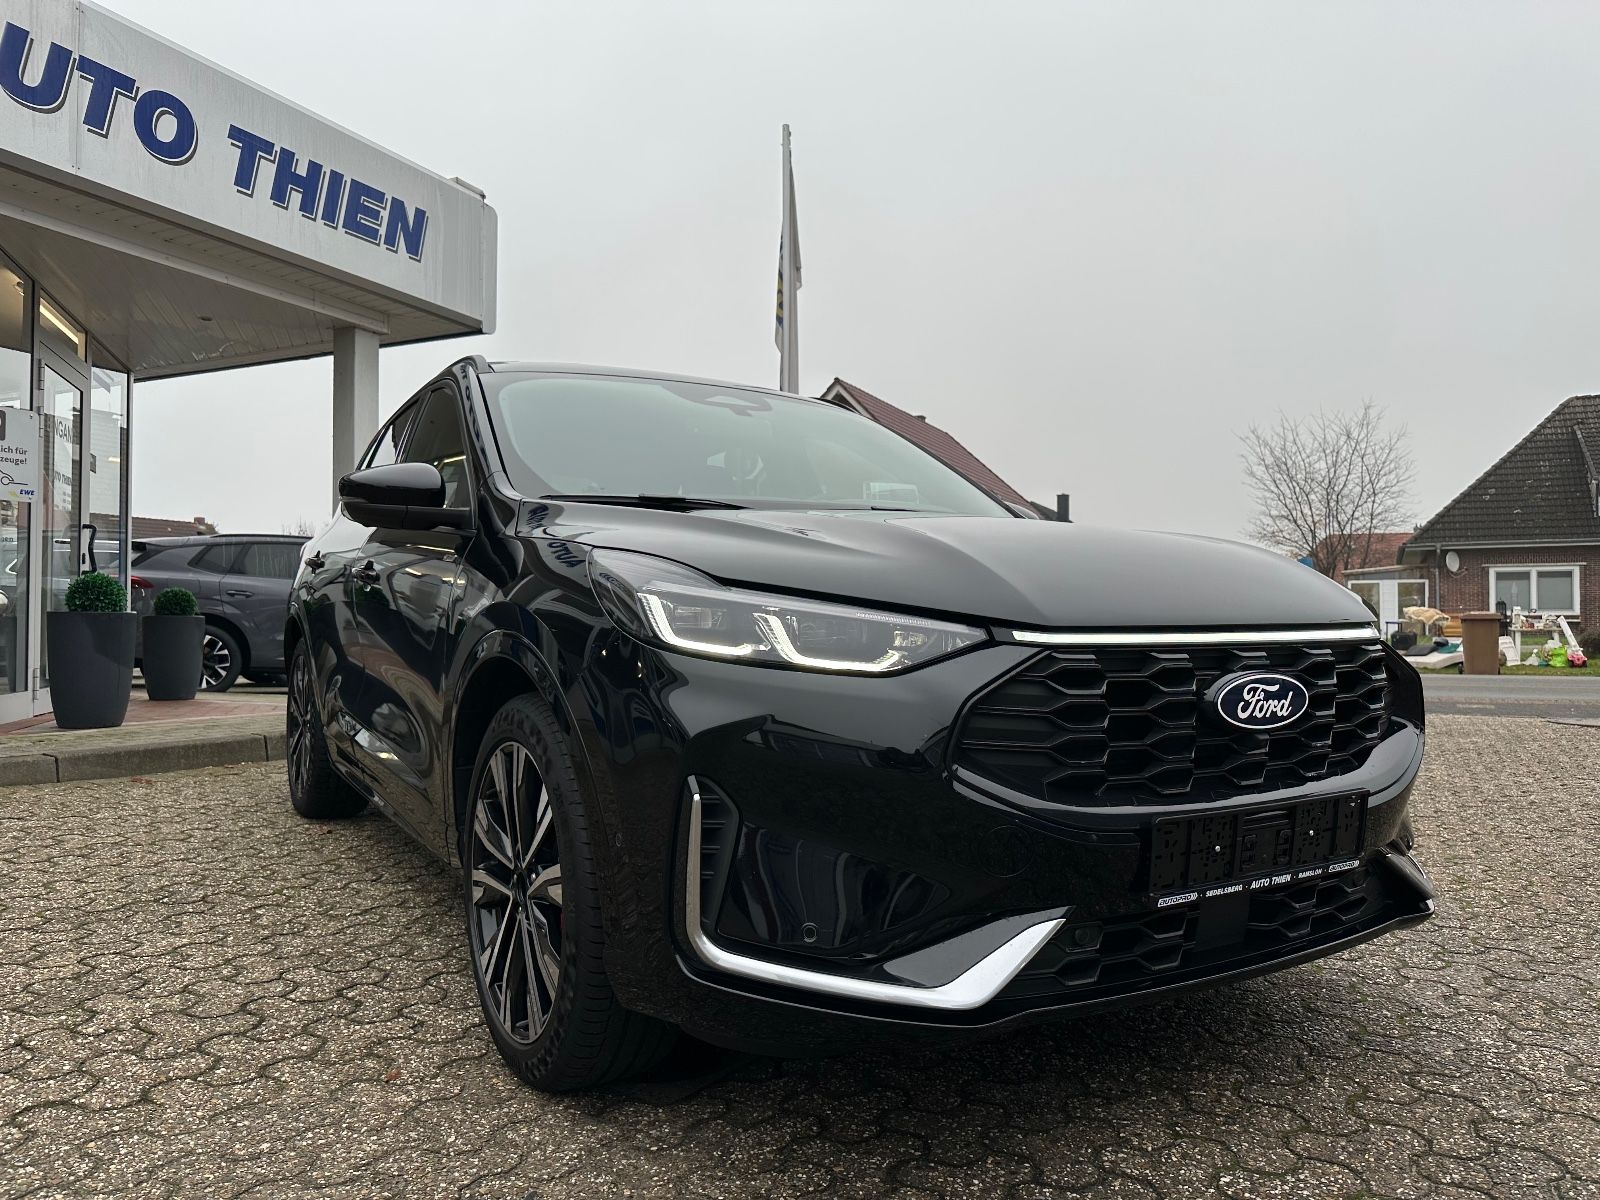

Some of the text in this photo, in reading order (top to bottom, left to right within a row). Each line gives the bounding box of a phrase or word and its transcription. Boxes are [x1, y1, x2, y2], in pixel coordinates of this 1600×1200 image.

[227, 124, 428, 262] THIEN
[15, 447, 27, 456] für
[20, 488, 35, 496] EWE
[1237, 683, 1294, 719] Ford
[1205, 884, 1243, 897] SEDELSBERG
[1250, 877, 1270, 890] AUTO
[1271, 873, 1292, 885] THIEN
